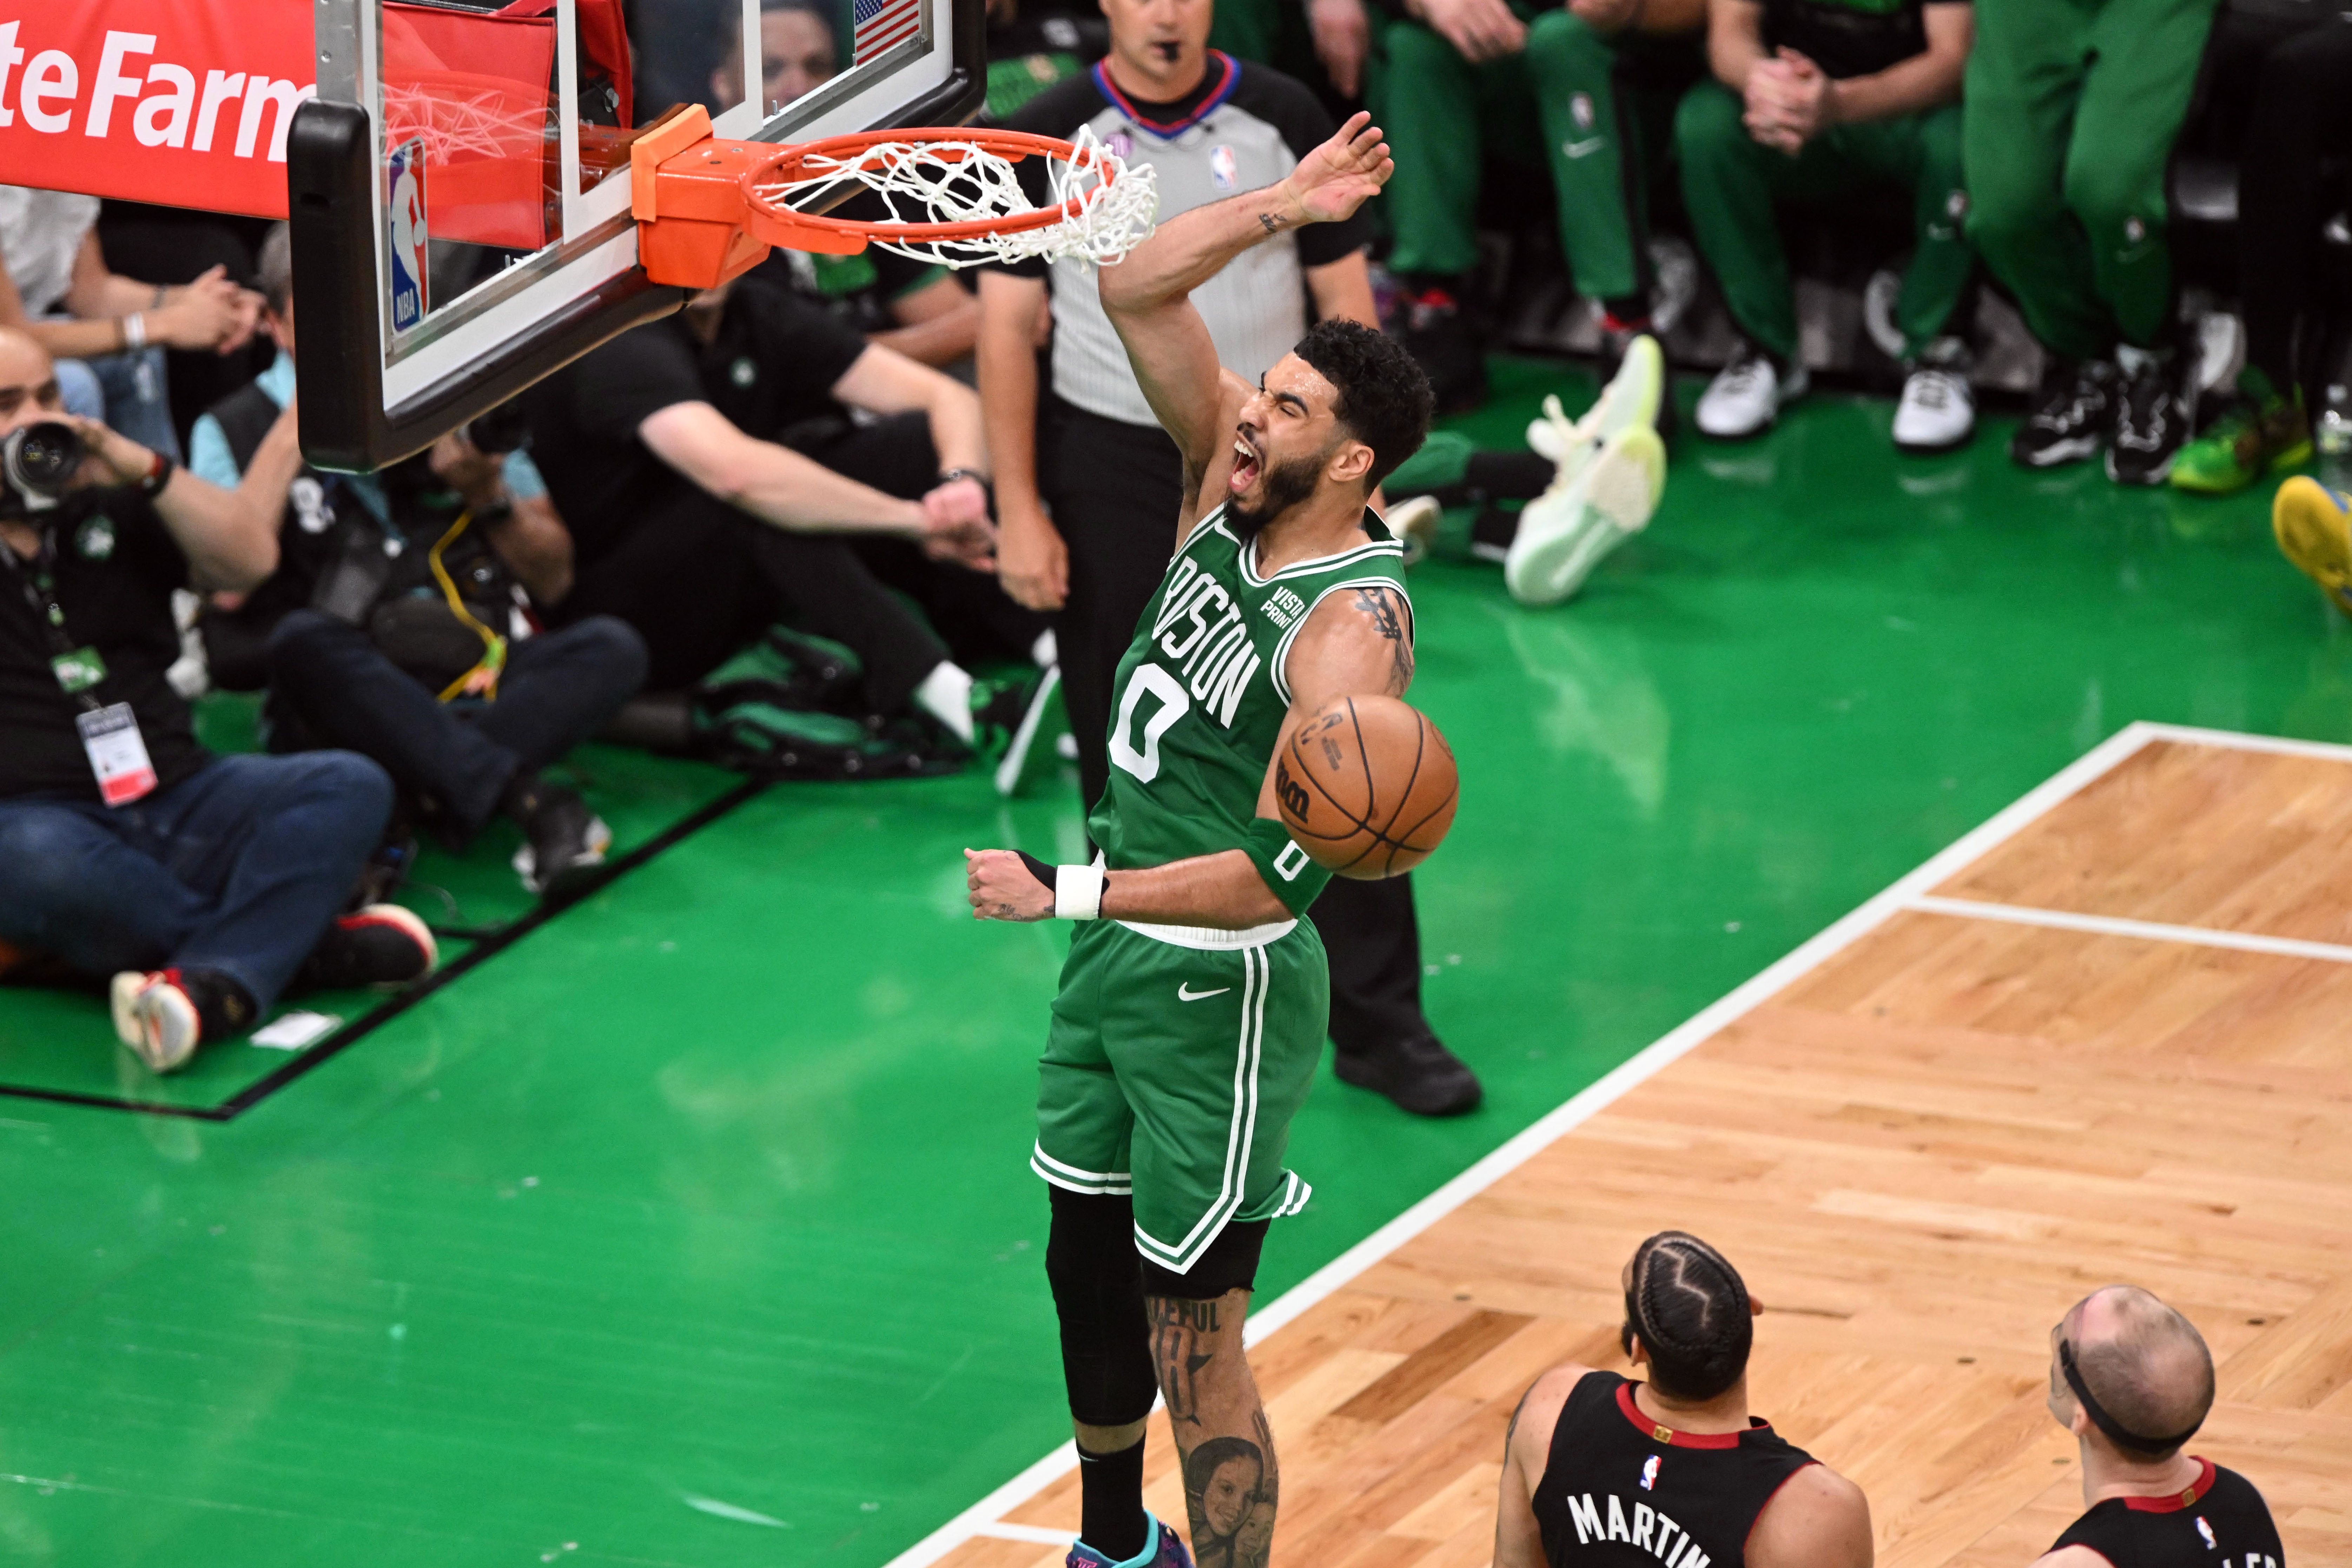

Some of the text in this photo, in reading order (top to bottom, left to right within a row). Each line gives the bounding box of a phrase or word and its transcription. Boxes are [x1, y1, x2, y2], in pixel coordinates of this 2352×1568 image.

[397, 288, 415, 324] NBA
[1260, 600, 1293, 629] PRINT
[1271, 585, 1305, 620] VISTA
[1108, 663, 1189, 784] 0
[1273, 839, 1310, 881] 0
